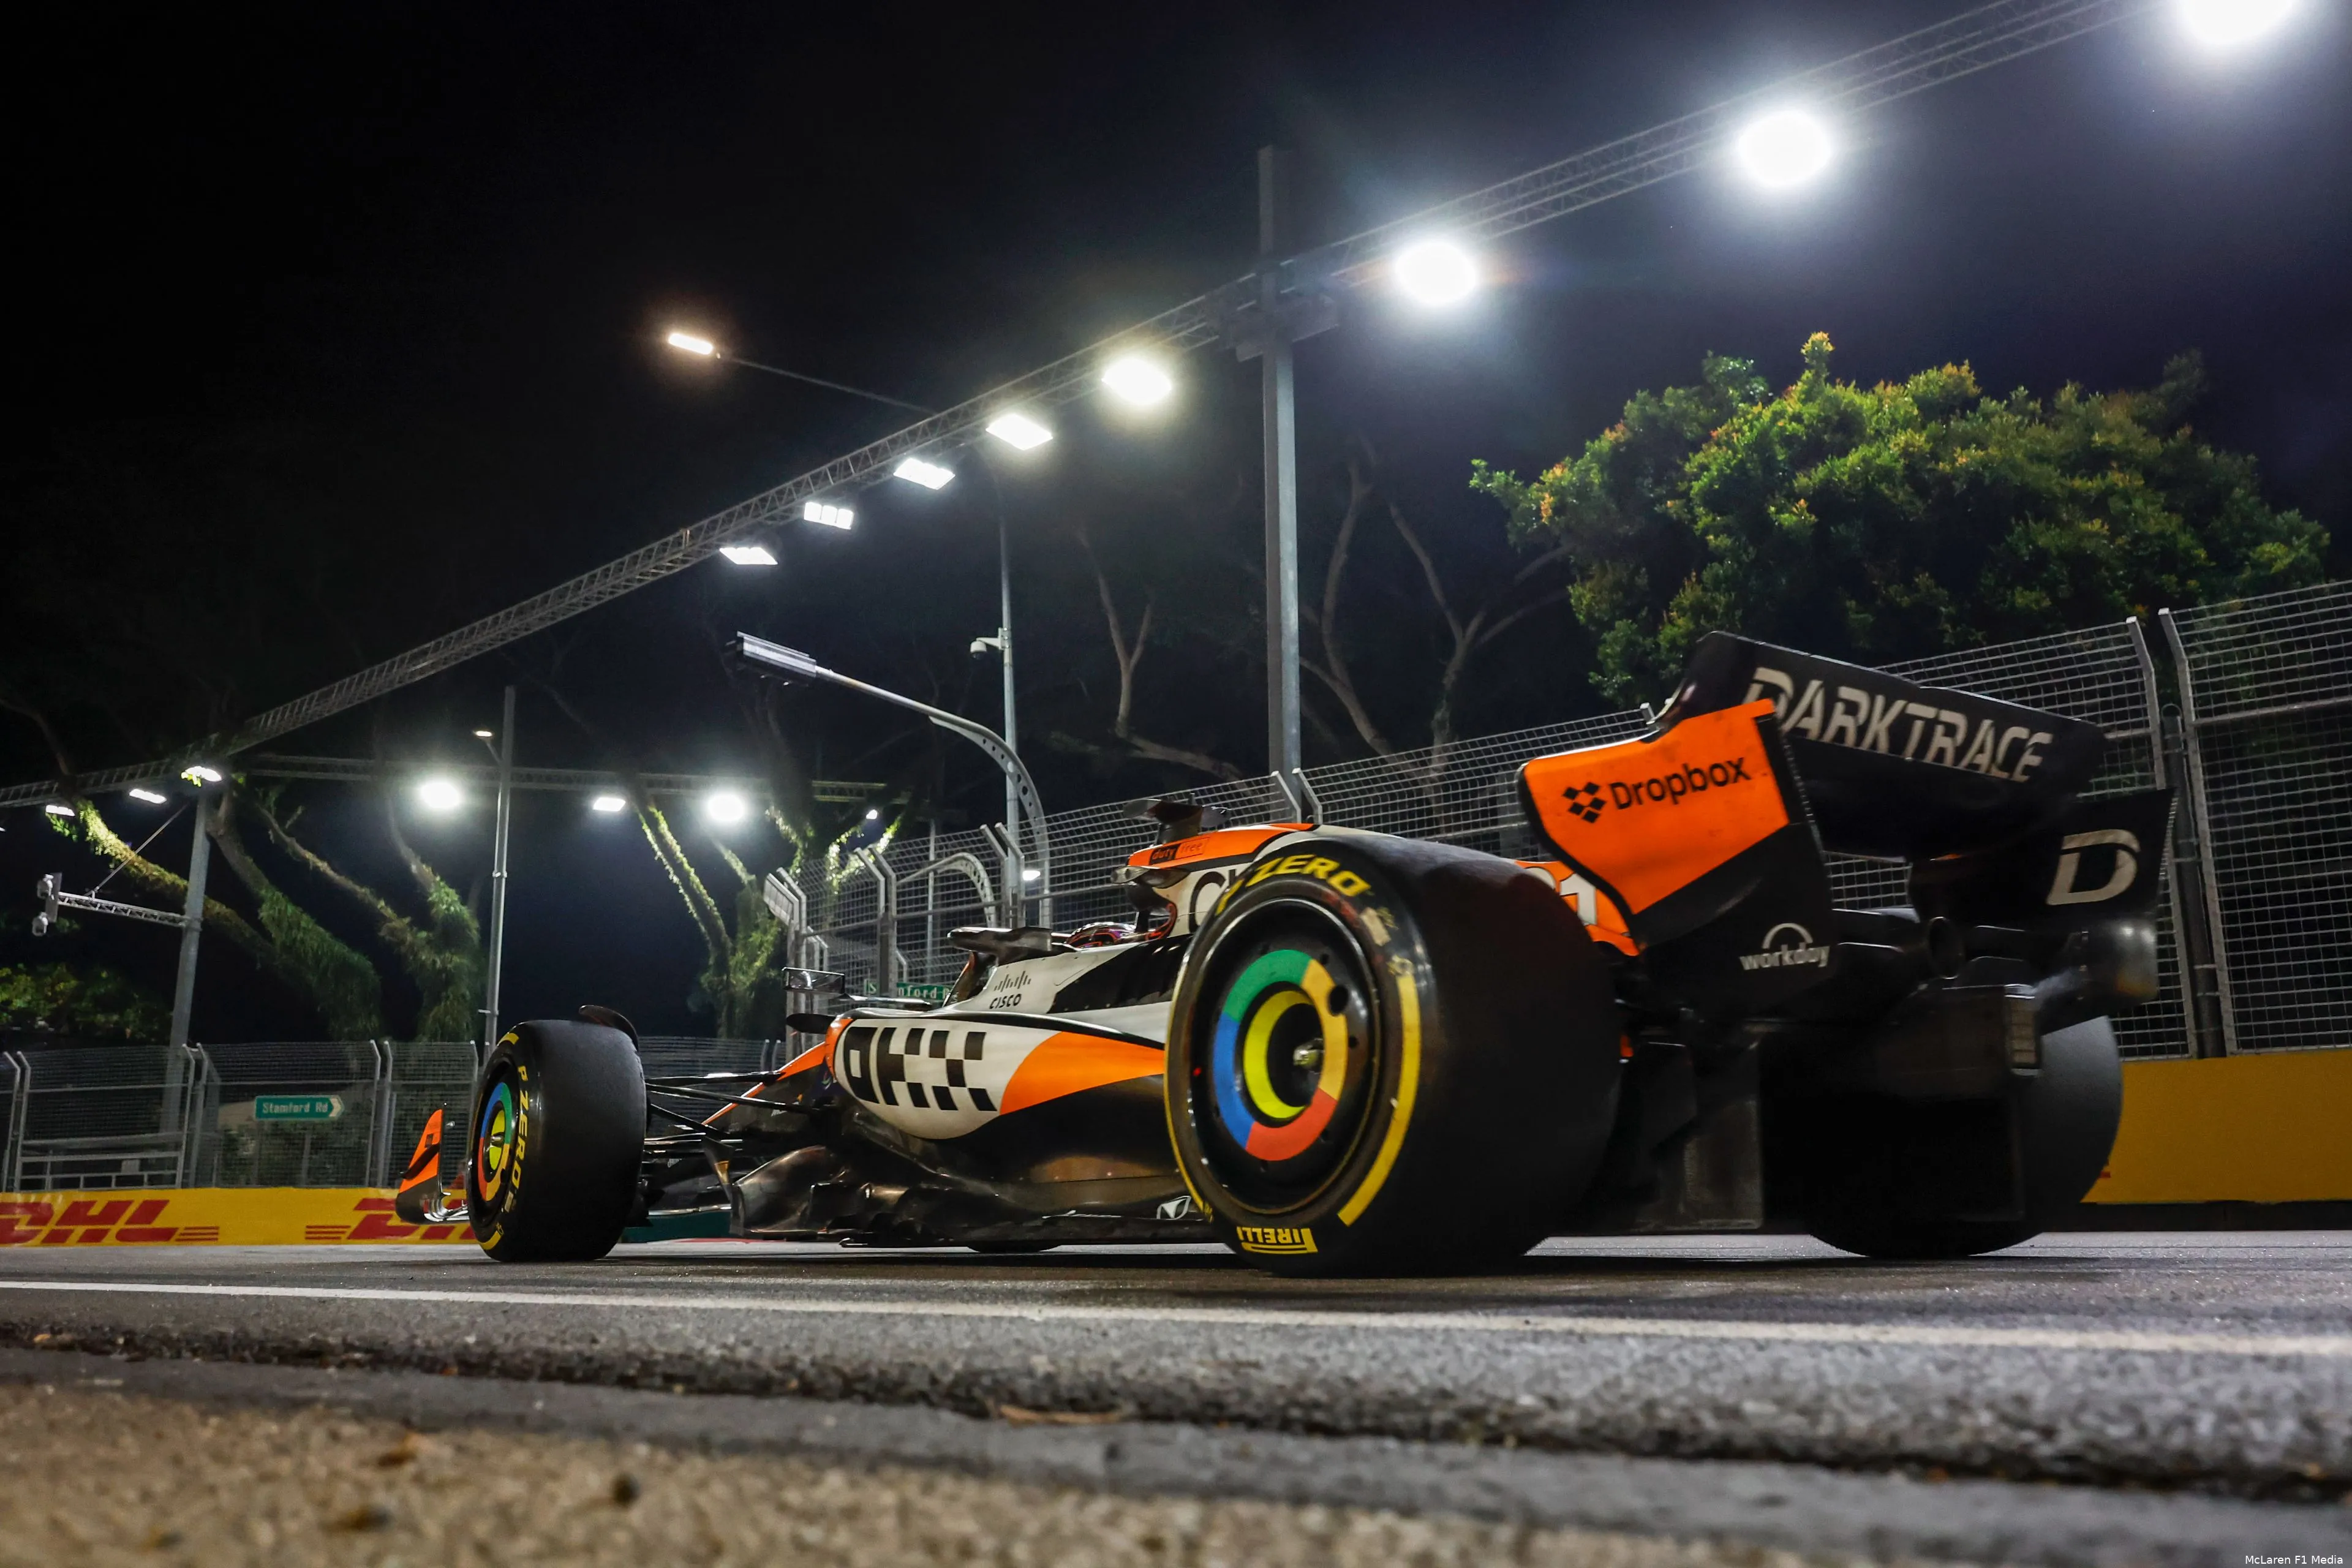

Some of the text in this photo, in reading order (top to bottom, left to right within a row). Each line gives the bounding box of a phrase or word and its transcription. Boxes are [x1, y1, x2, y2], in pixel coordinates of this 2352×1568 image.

[1743, 667, 2053, 782] DARKTRACE
[1609, 757, 1752, 810] Dropbox
[1152, 842, 1203, 861] duty free
[1245, 854, 1371, 897] ZERO
[2046, 829, 2141, 905] D
[1740, 943, 1830, 970] workday
[843, 1027, 998, 1112] OKX
[262, 1102, 328, 1114] Stamford Rd
[511, 1066, 529, 1189] P ZERO
[1236, 1226, 1318, 1254] PIRELLI
